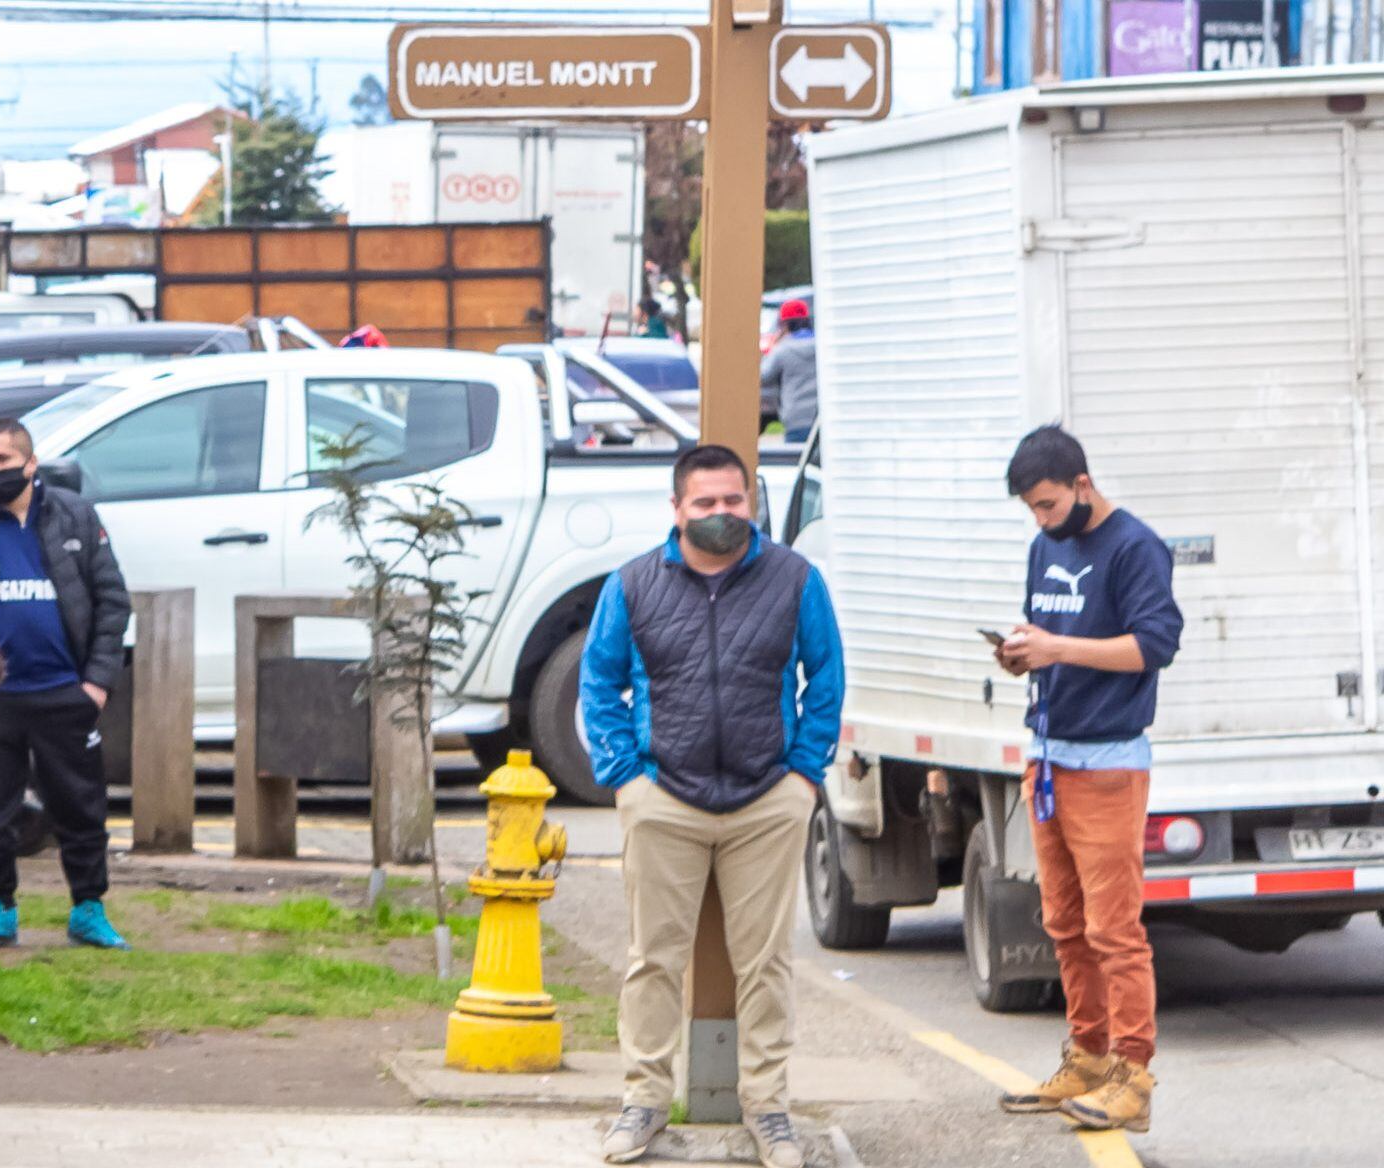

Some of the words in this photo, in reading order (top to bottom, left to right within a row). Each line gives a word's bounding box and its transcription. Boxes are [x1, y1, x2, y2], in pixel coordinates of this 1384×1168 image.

[415, 61, 544, 87] MANUEL
[550, 60, 658, 87] MONTT
[1031, 592, 1085, 614] PUMA
